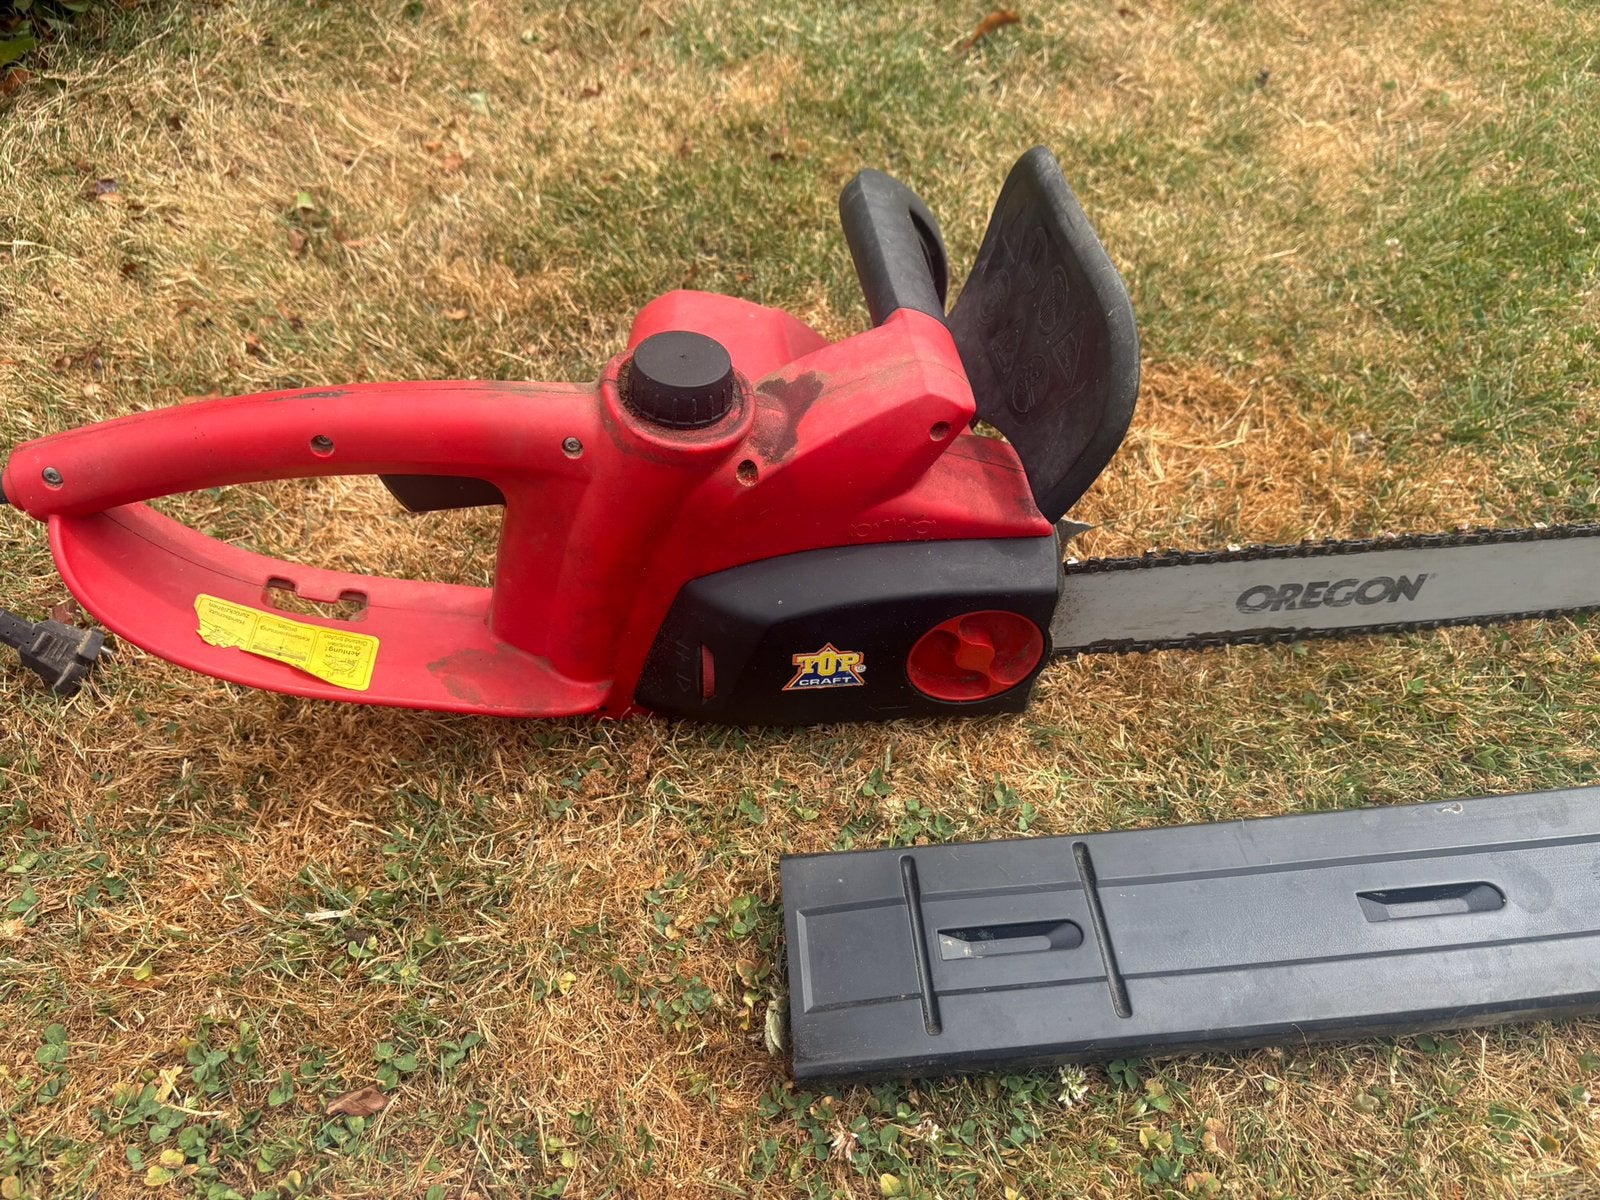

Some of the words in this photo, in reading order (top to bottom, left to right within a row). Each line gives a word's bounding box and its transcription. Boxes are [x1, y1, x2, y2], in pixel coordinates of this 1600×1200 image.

[1235, 573, 1429, 614] OREGON
[325, 645, 361, 657] Achtung!
[796, 650, 860, 677] TOP
[799, 676, 852, 686] CRAFT
